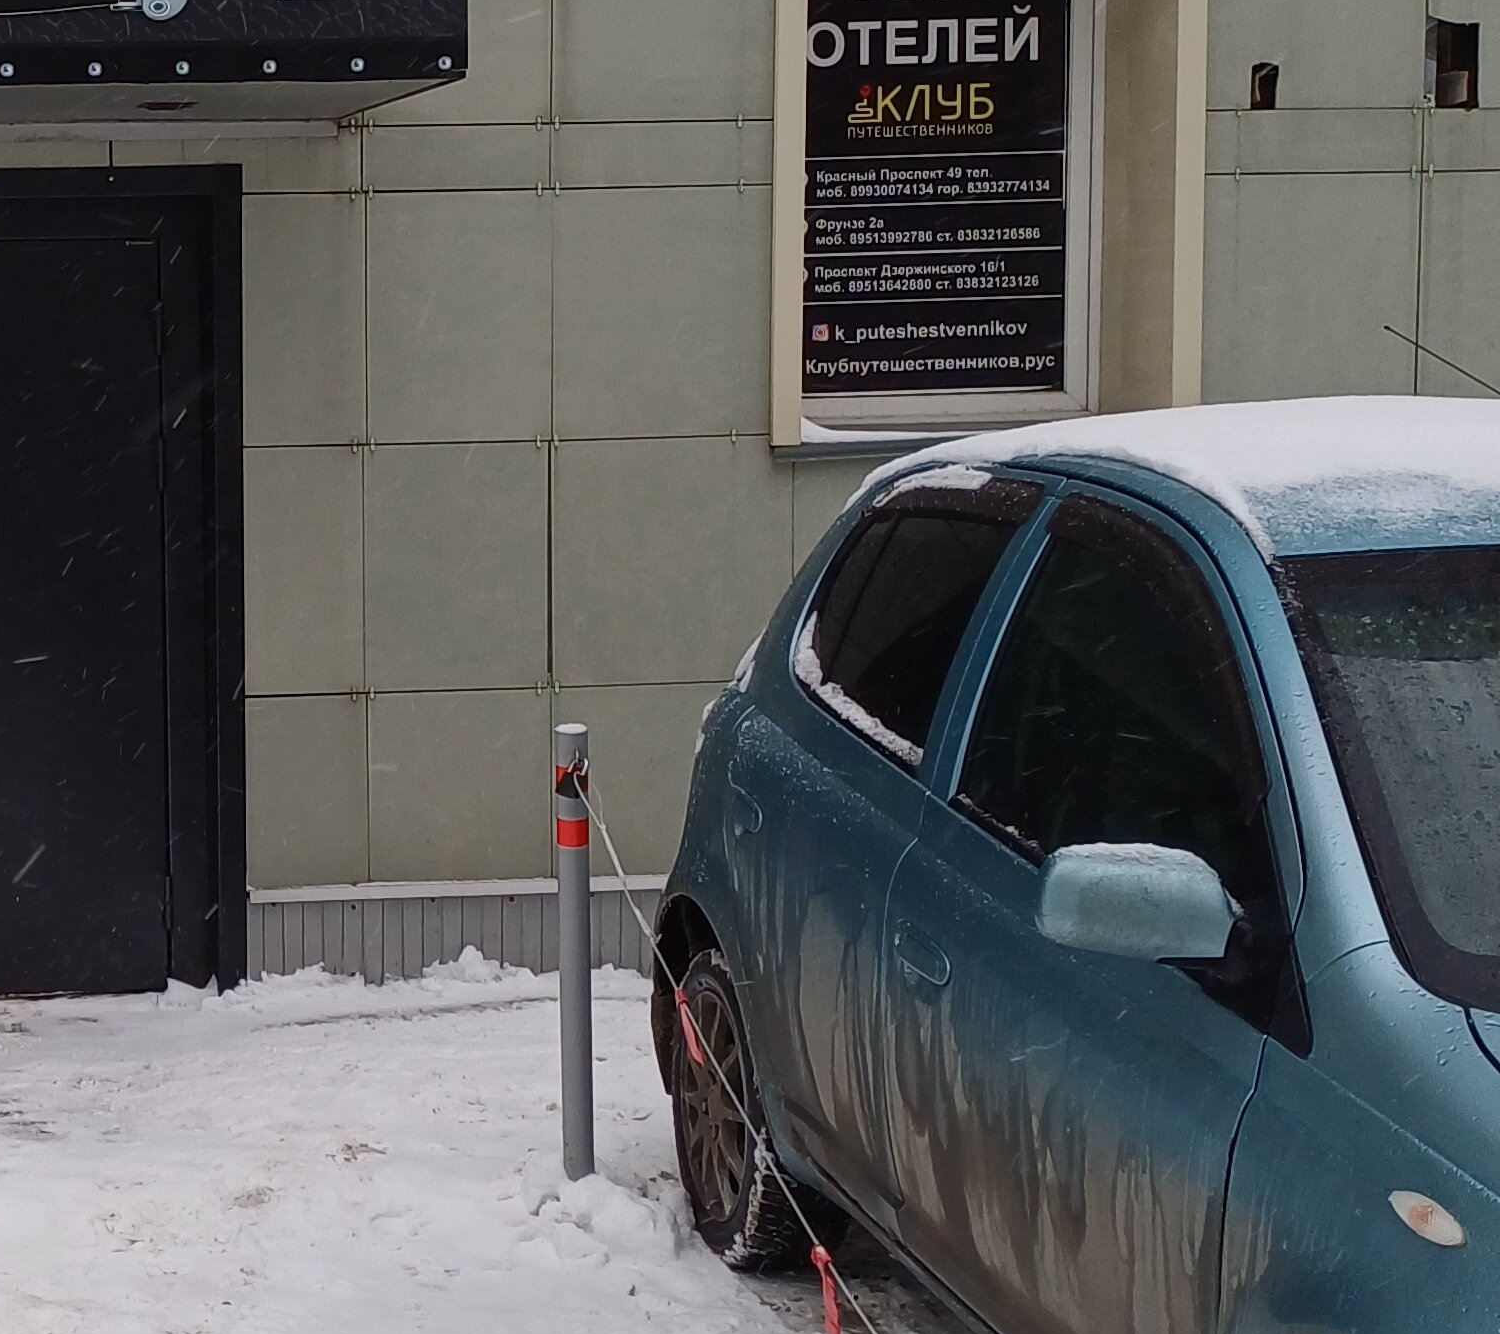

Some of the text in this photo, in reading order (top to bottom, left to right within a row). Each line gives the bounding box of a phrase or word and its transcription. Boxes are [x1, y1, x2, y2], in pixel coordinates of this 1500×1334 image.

[806, 4, 1039, 67] ОТЕЛЕЙ
[877, 83, 994, 122] КЛУБ
[847, 123, 993, 139] ПУТЕШЕСТВЕННИКОВ
[946, 167, 962, 178] 49
[816, 186, 847, 198] моб.
[815, 234, 846, 246] моб.
[814, 282, 845, 294] моб.
[835, 321, 1028, 344] k_puteshestvennikov
[806, 355, 1056, 377] Клубпутешественников.рус
